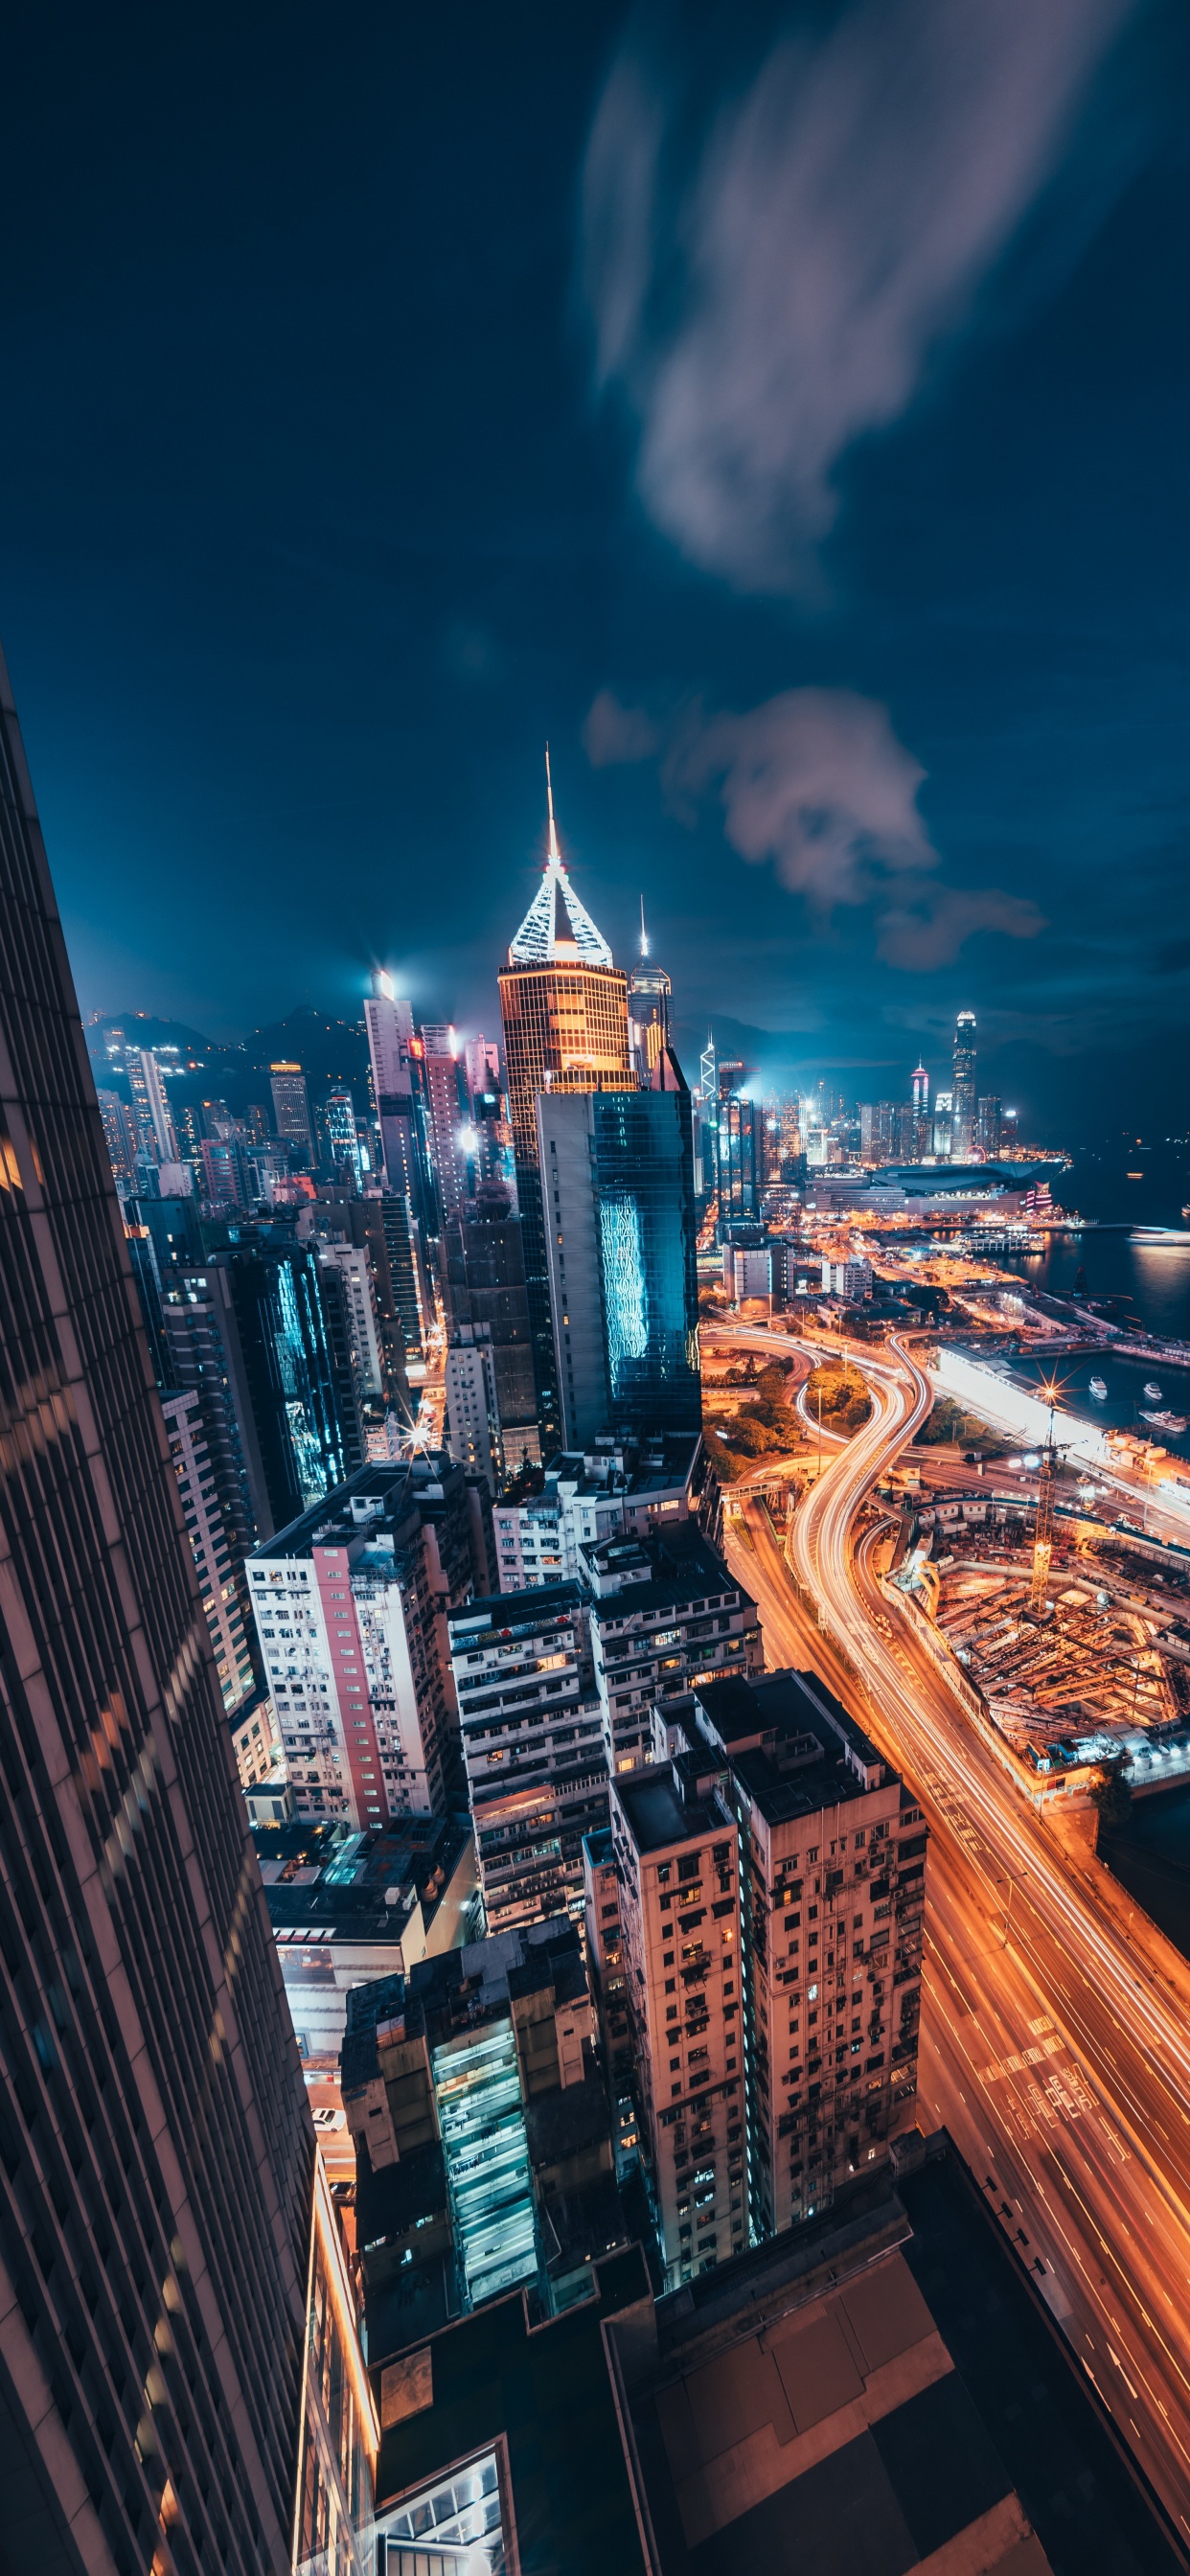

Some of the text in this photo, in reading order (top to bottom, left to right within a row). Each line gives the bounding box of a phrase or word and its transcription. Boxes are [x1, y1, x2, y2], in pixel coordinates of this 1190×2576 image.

[969, 1840, 982, 1852] TAI
[1041, 2034, 1065, 2055] NORTH
[1021, 2046, 1046, 2065] CENTRAL
[1022, 2082, 1060, 2130] 中區
[1041, 2074, 1081, 2121] 中區
